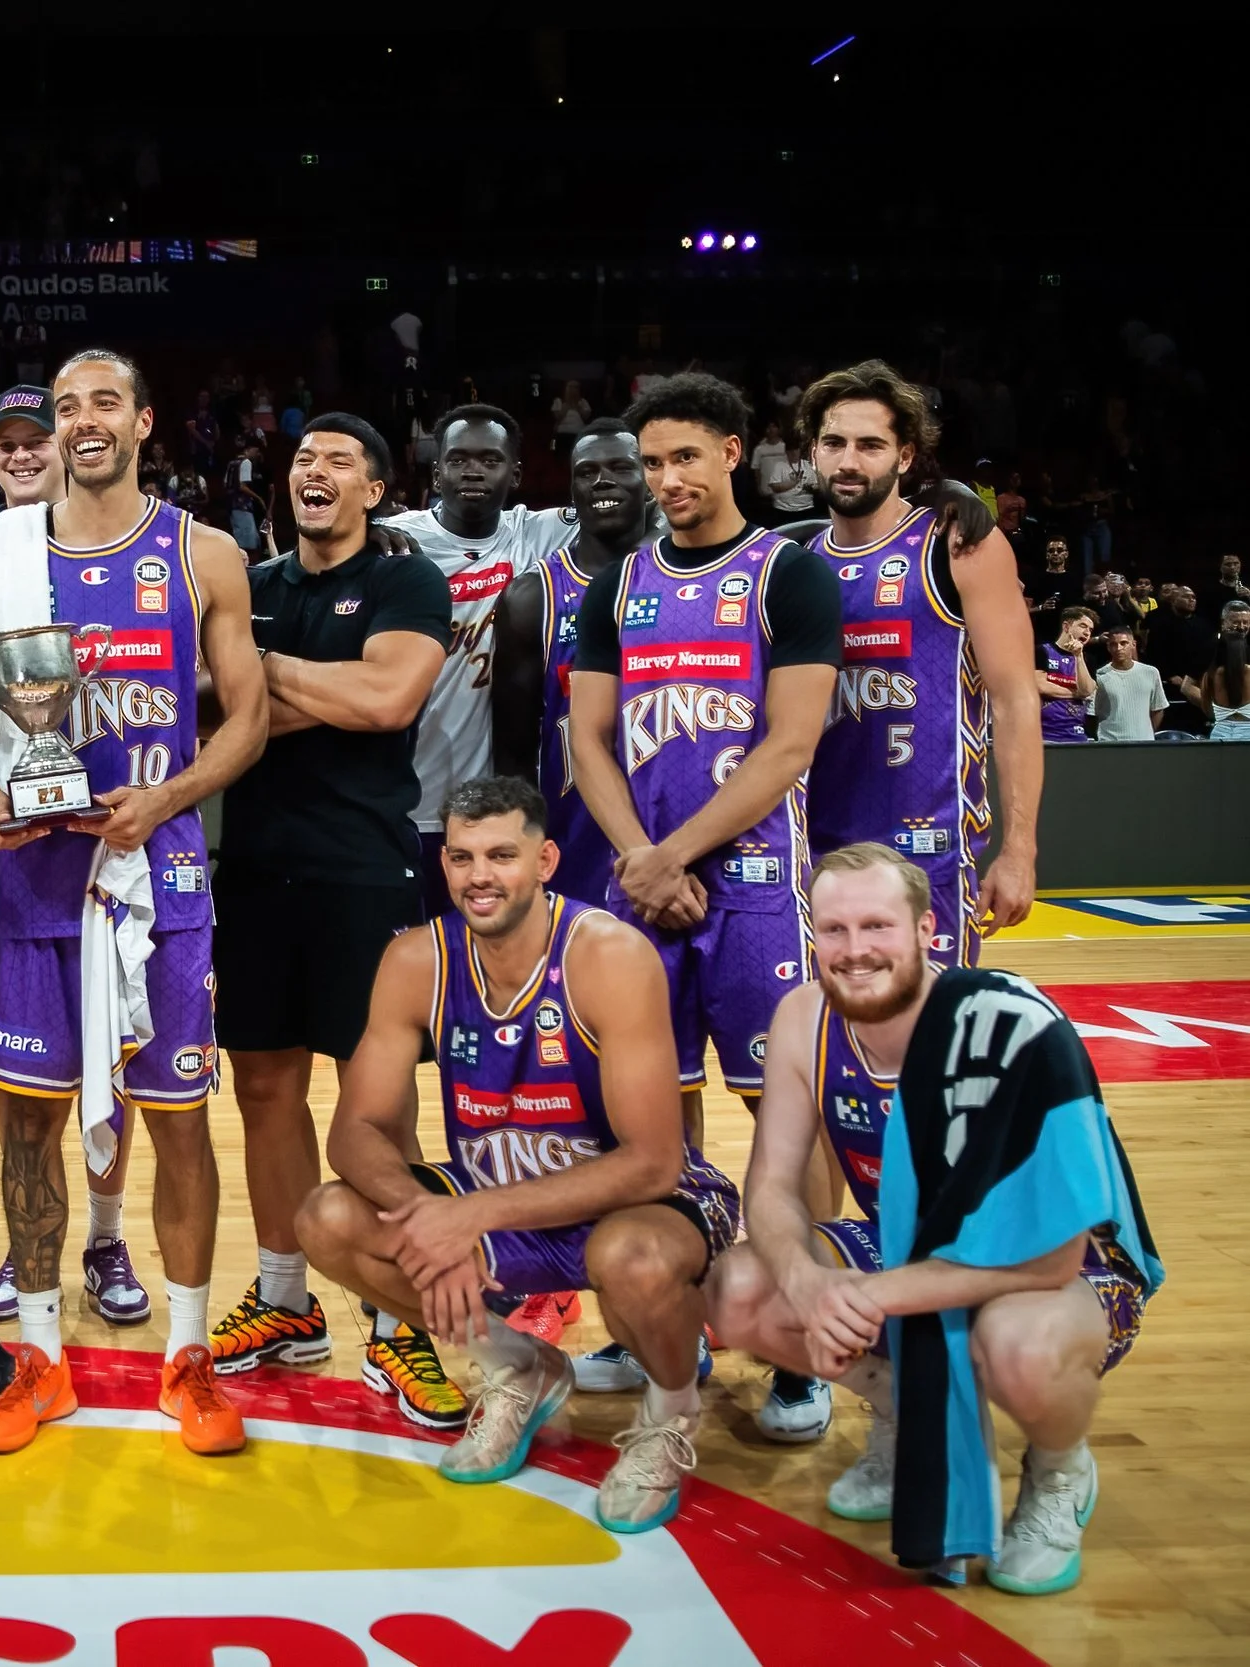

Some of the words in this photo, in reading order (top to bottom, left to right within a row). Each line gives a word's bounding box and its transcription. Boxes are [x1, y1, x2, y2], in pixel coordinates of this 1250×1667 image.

[0, 273, 94, 297] Qudos
[98, 271, 170, 293] Bank
[0, 392, 44, 411] KINGS
[141, 567, 162, 579] NBL
[724, 580, 744, 594] NBL
[625, 617, 655, 626] HOSTPLUS
[844, 632, 900, 648] Norman
[95, 641, 162, 659] Norman
[627, 655, 677, 671] Harvey
[678, 652, 740, 667] Norman
[58, 678, 178, 751] INGS
[622, 684, 756, 778] KINGS
[887, 724, 915, 767] 5
[128, 743, 171, 789] 10
[180, 1055, 199, 1070] NBL
[511, 1093, 572, 1112] Norman
[457, 1129, 601, 1191] KINGS
